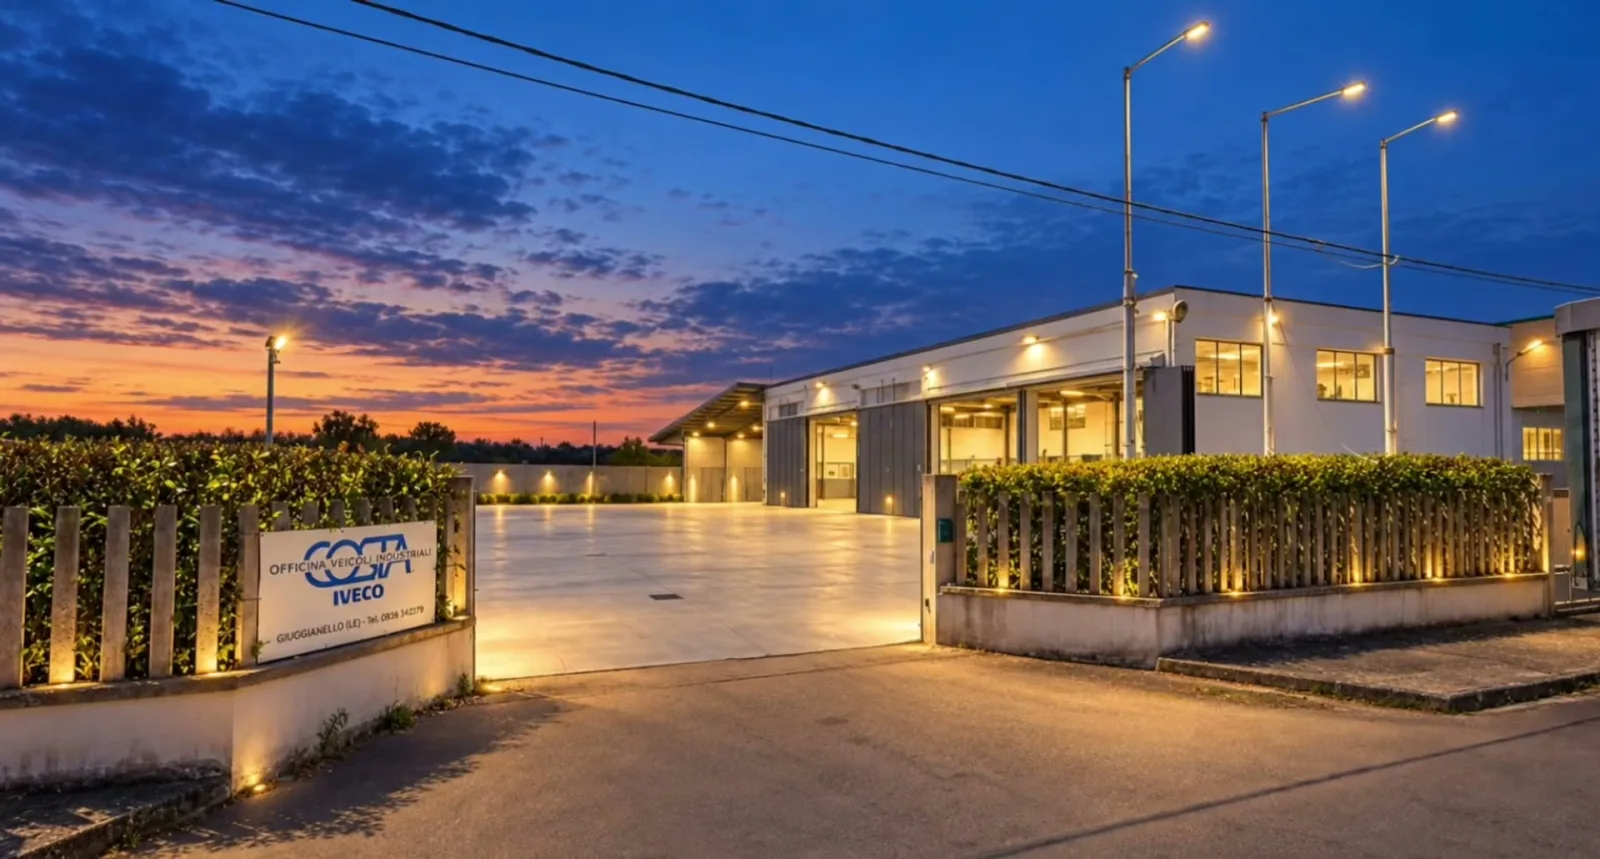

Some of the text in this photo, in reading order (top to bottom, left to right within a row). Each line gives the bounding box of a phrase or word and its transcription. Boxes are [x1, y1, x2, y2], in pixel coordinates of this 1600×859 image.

[269, 548, 432, 575] OFFICINA VEICOLI INDUSTRIALI
[333, 584, 385, 606] IVECO
[276, 621, 344, 643] GIUGGIANELLO
[346, 618, 361, 629] (LE)
[367, 615, 379, 625] Tel.
